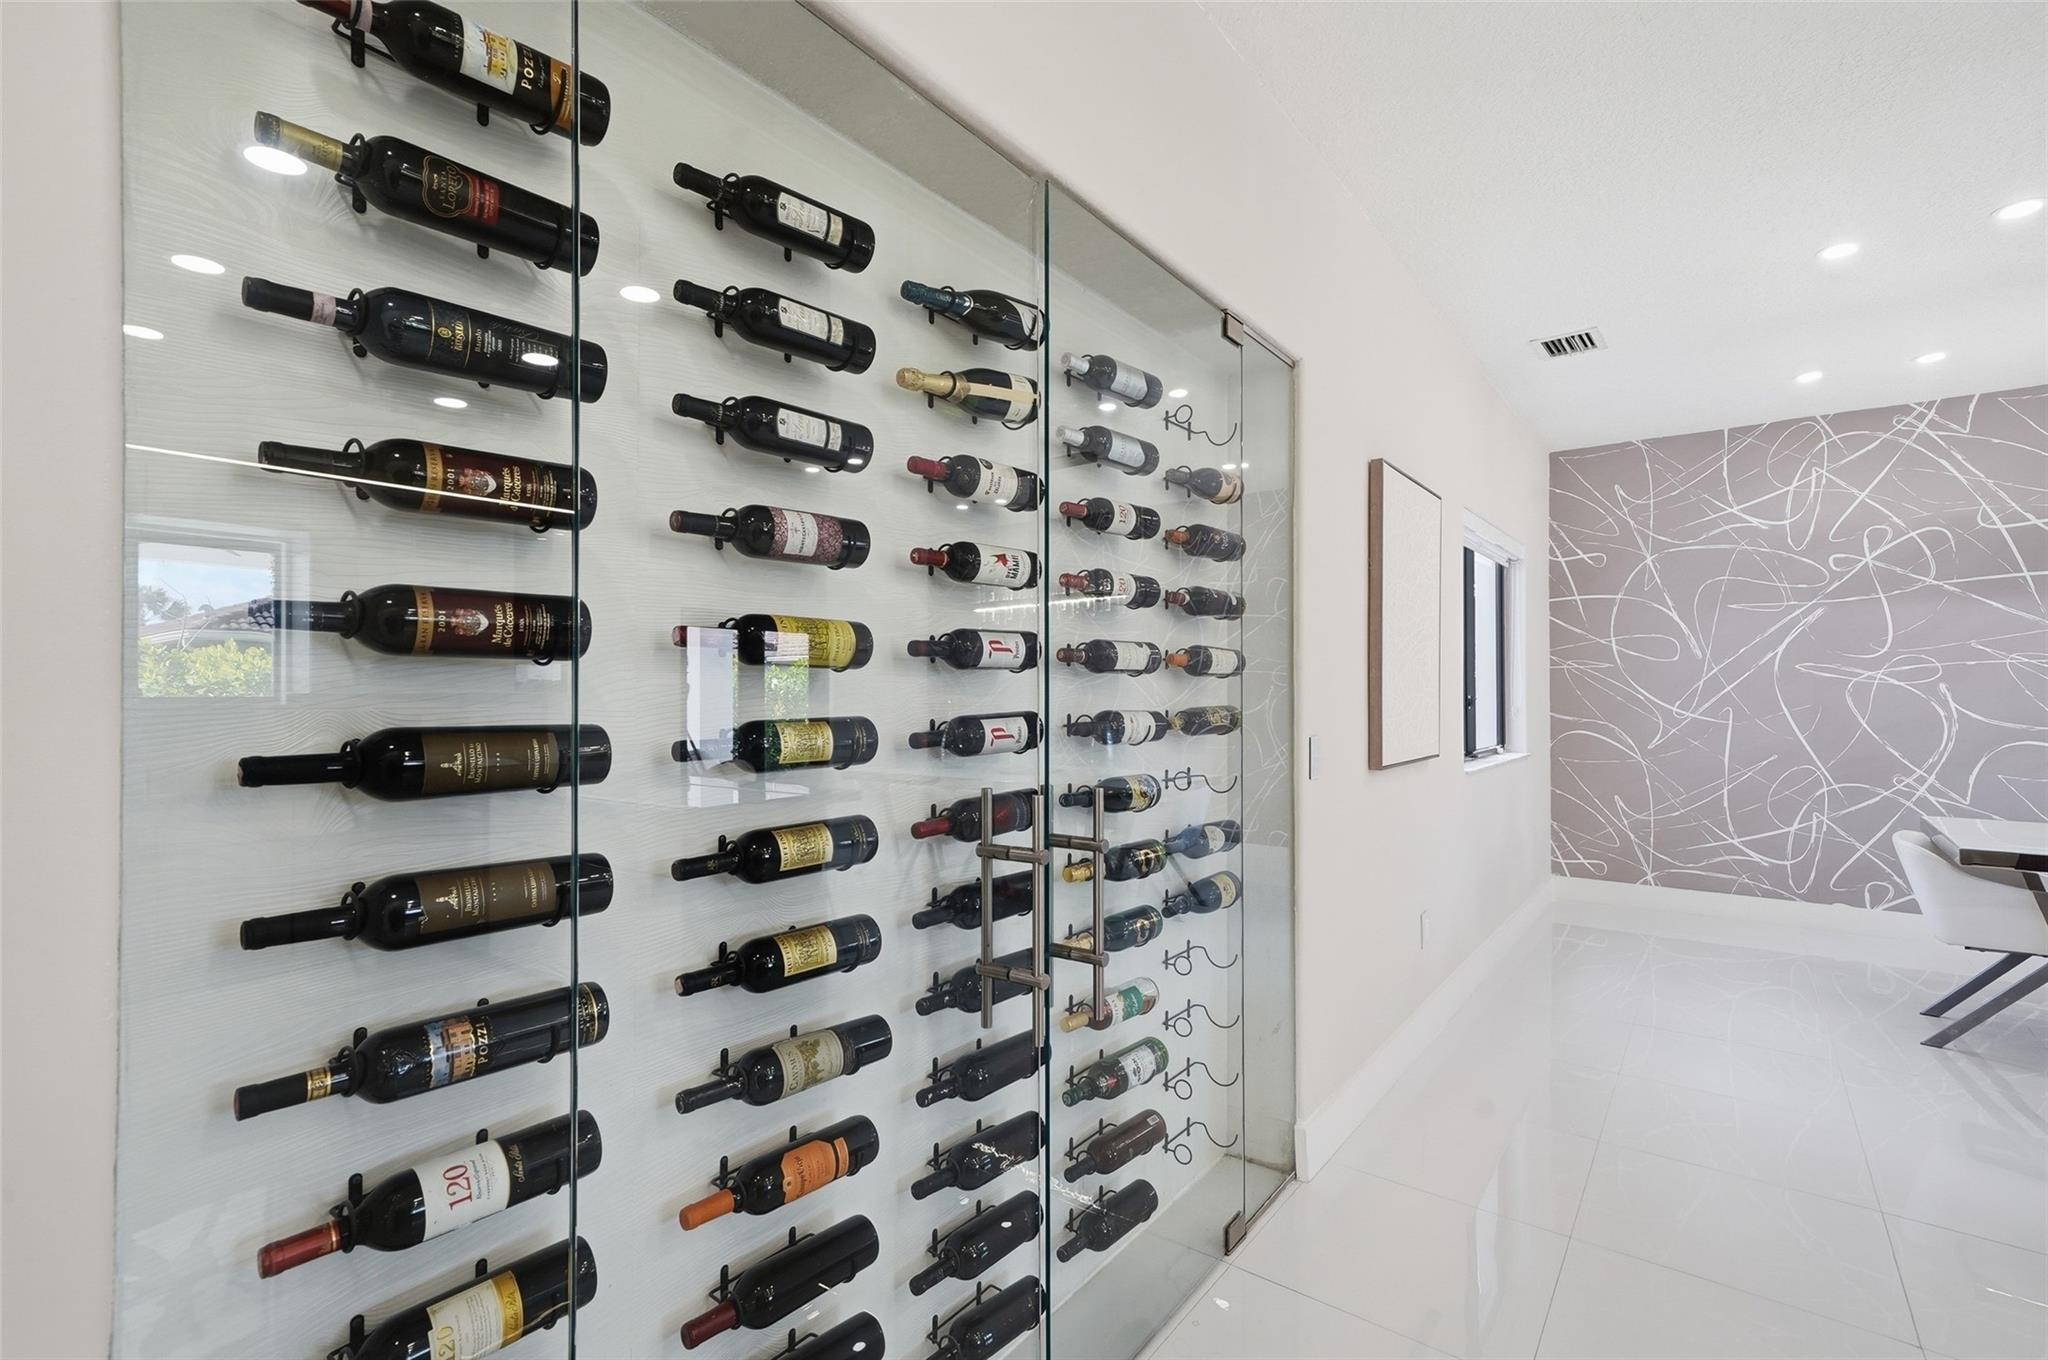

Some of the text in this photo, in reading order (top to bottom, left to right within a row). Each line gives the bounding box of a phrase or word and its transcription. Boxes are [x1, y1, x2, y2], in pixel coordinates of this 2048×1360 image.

[446, 467, 456, 491] 2001
[1118, 504, 1128, 525] 120
[438, 609, 446, 633] 2001
[776, 831, 790, 869] RUFFINO
[475, 1021, 489, 1065] POZZI
[443, 1164, 473, 1211] 120
